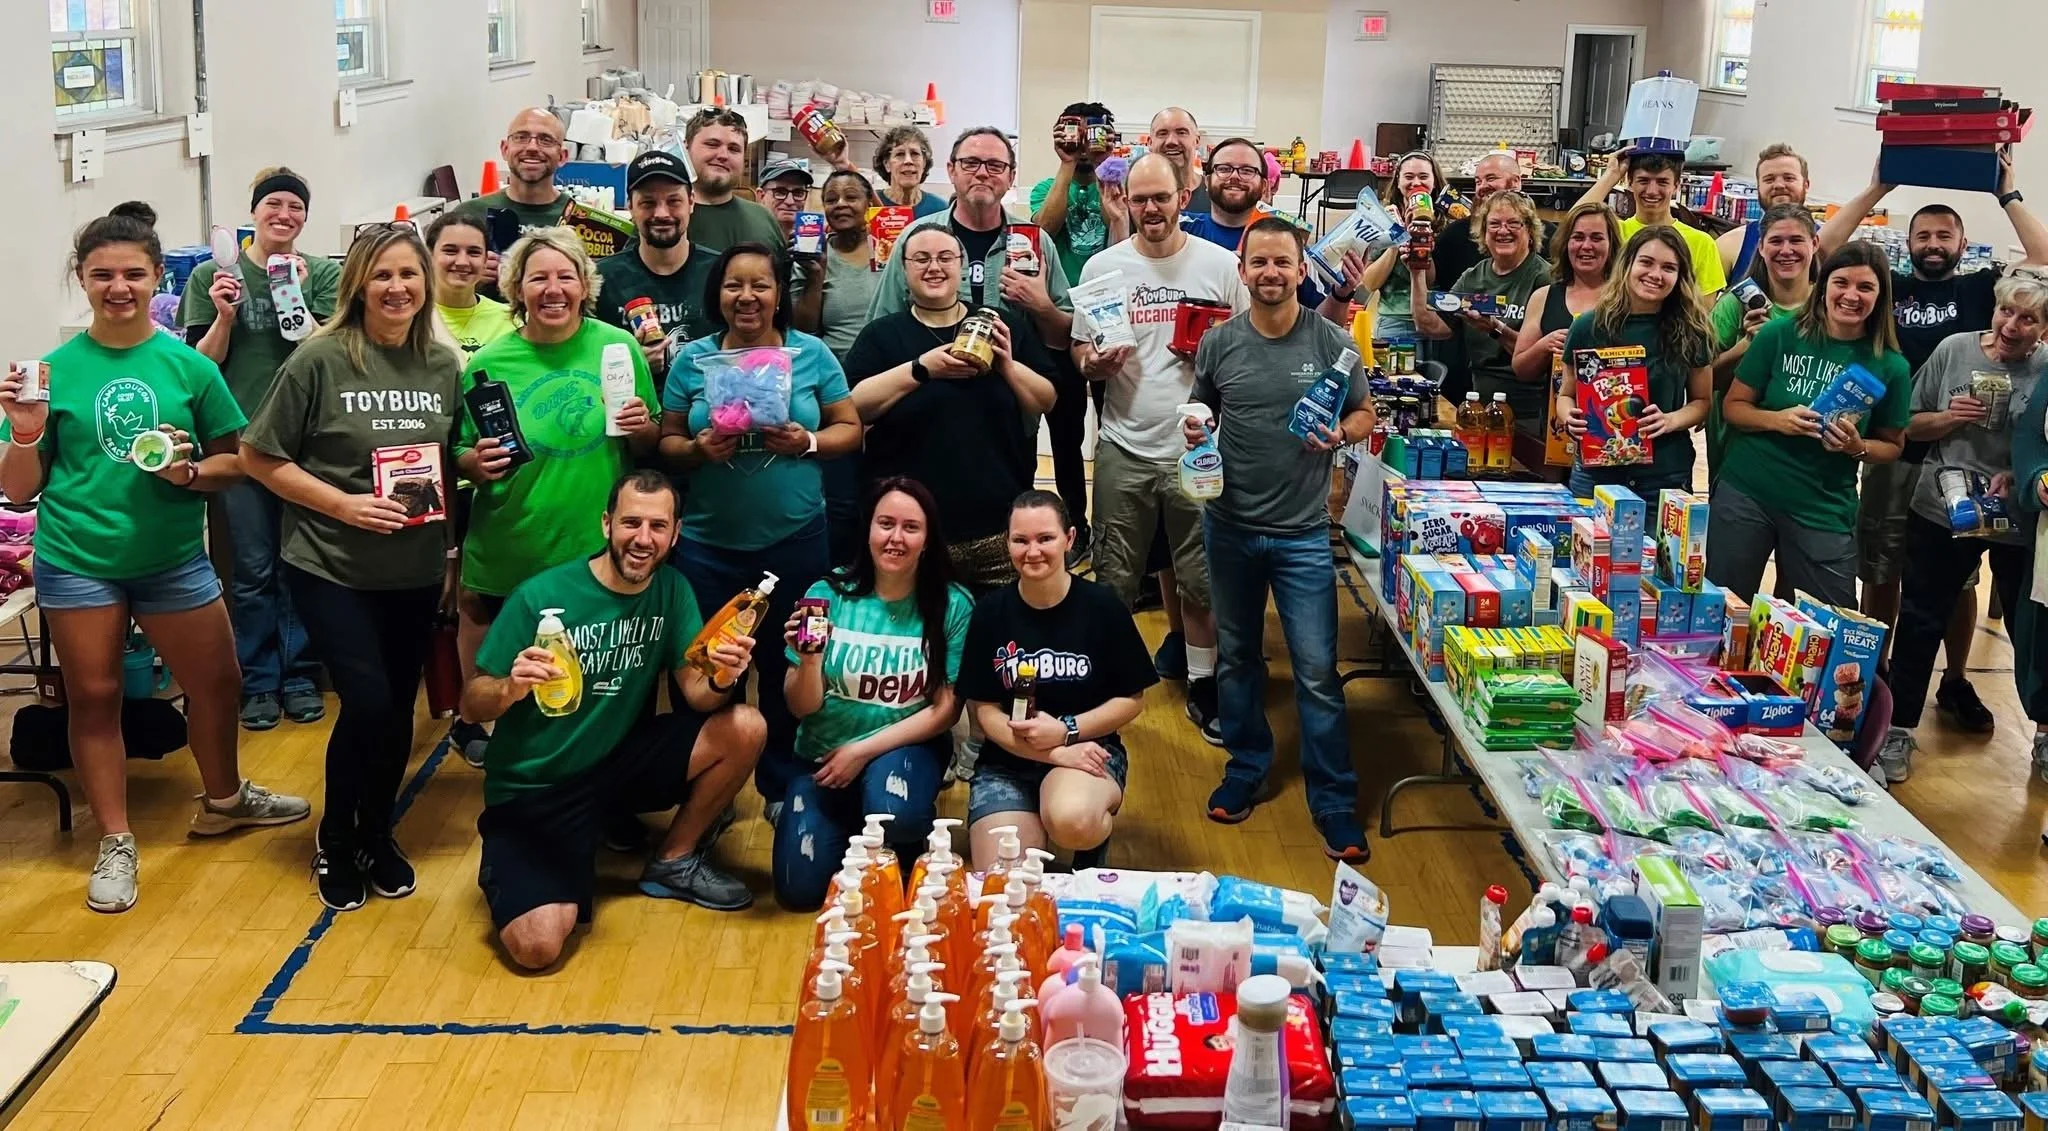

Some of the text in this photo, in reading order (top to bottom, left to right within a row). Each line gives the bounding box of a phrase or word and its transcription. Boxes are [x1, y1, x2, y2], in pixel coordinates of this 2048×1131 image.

[934, 1, 952, 15] EXIT
[575, 223, 615, 244] COCOA
[1628, 348, 1645, 356] SIZE
[1782, 353, 1815, 378] MOST
[1592, 372, 1631, 393] FROOT
[1786, 376, 1818, 398] SAVE
[101, 385, 117, 408] CAMP
[118, 382, 151, 403] LOUCON
[1598, 383, 1634, 401] LOOPS
[340, 390, 442, 414] TOYBURG
[371, 418, 427, 430] EST. 2006
[104, 437, 128, 458] PEACE
[1422, 517, 1446, 531] ZERO
[1537, 522, 1556, 534] SUN
[1421, 524, 1453, 541] SUGAR
[1480, 598, 1490, 606] 24
[1695, 616, 1705, 625] 24
[566, 622, 607, 650] MOST
[649, 616, 665, 642] TO
[1843, 634, 1877, 650] TREATS
[1703, 705, 1736, 720] Ziploc
[1761, 704, 1794, 720] Ziploc
[1819, 708, 1836, 723] 64
